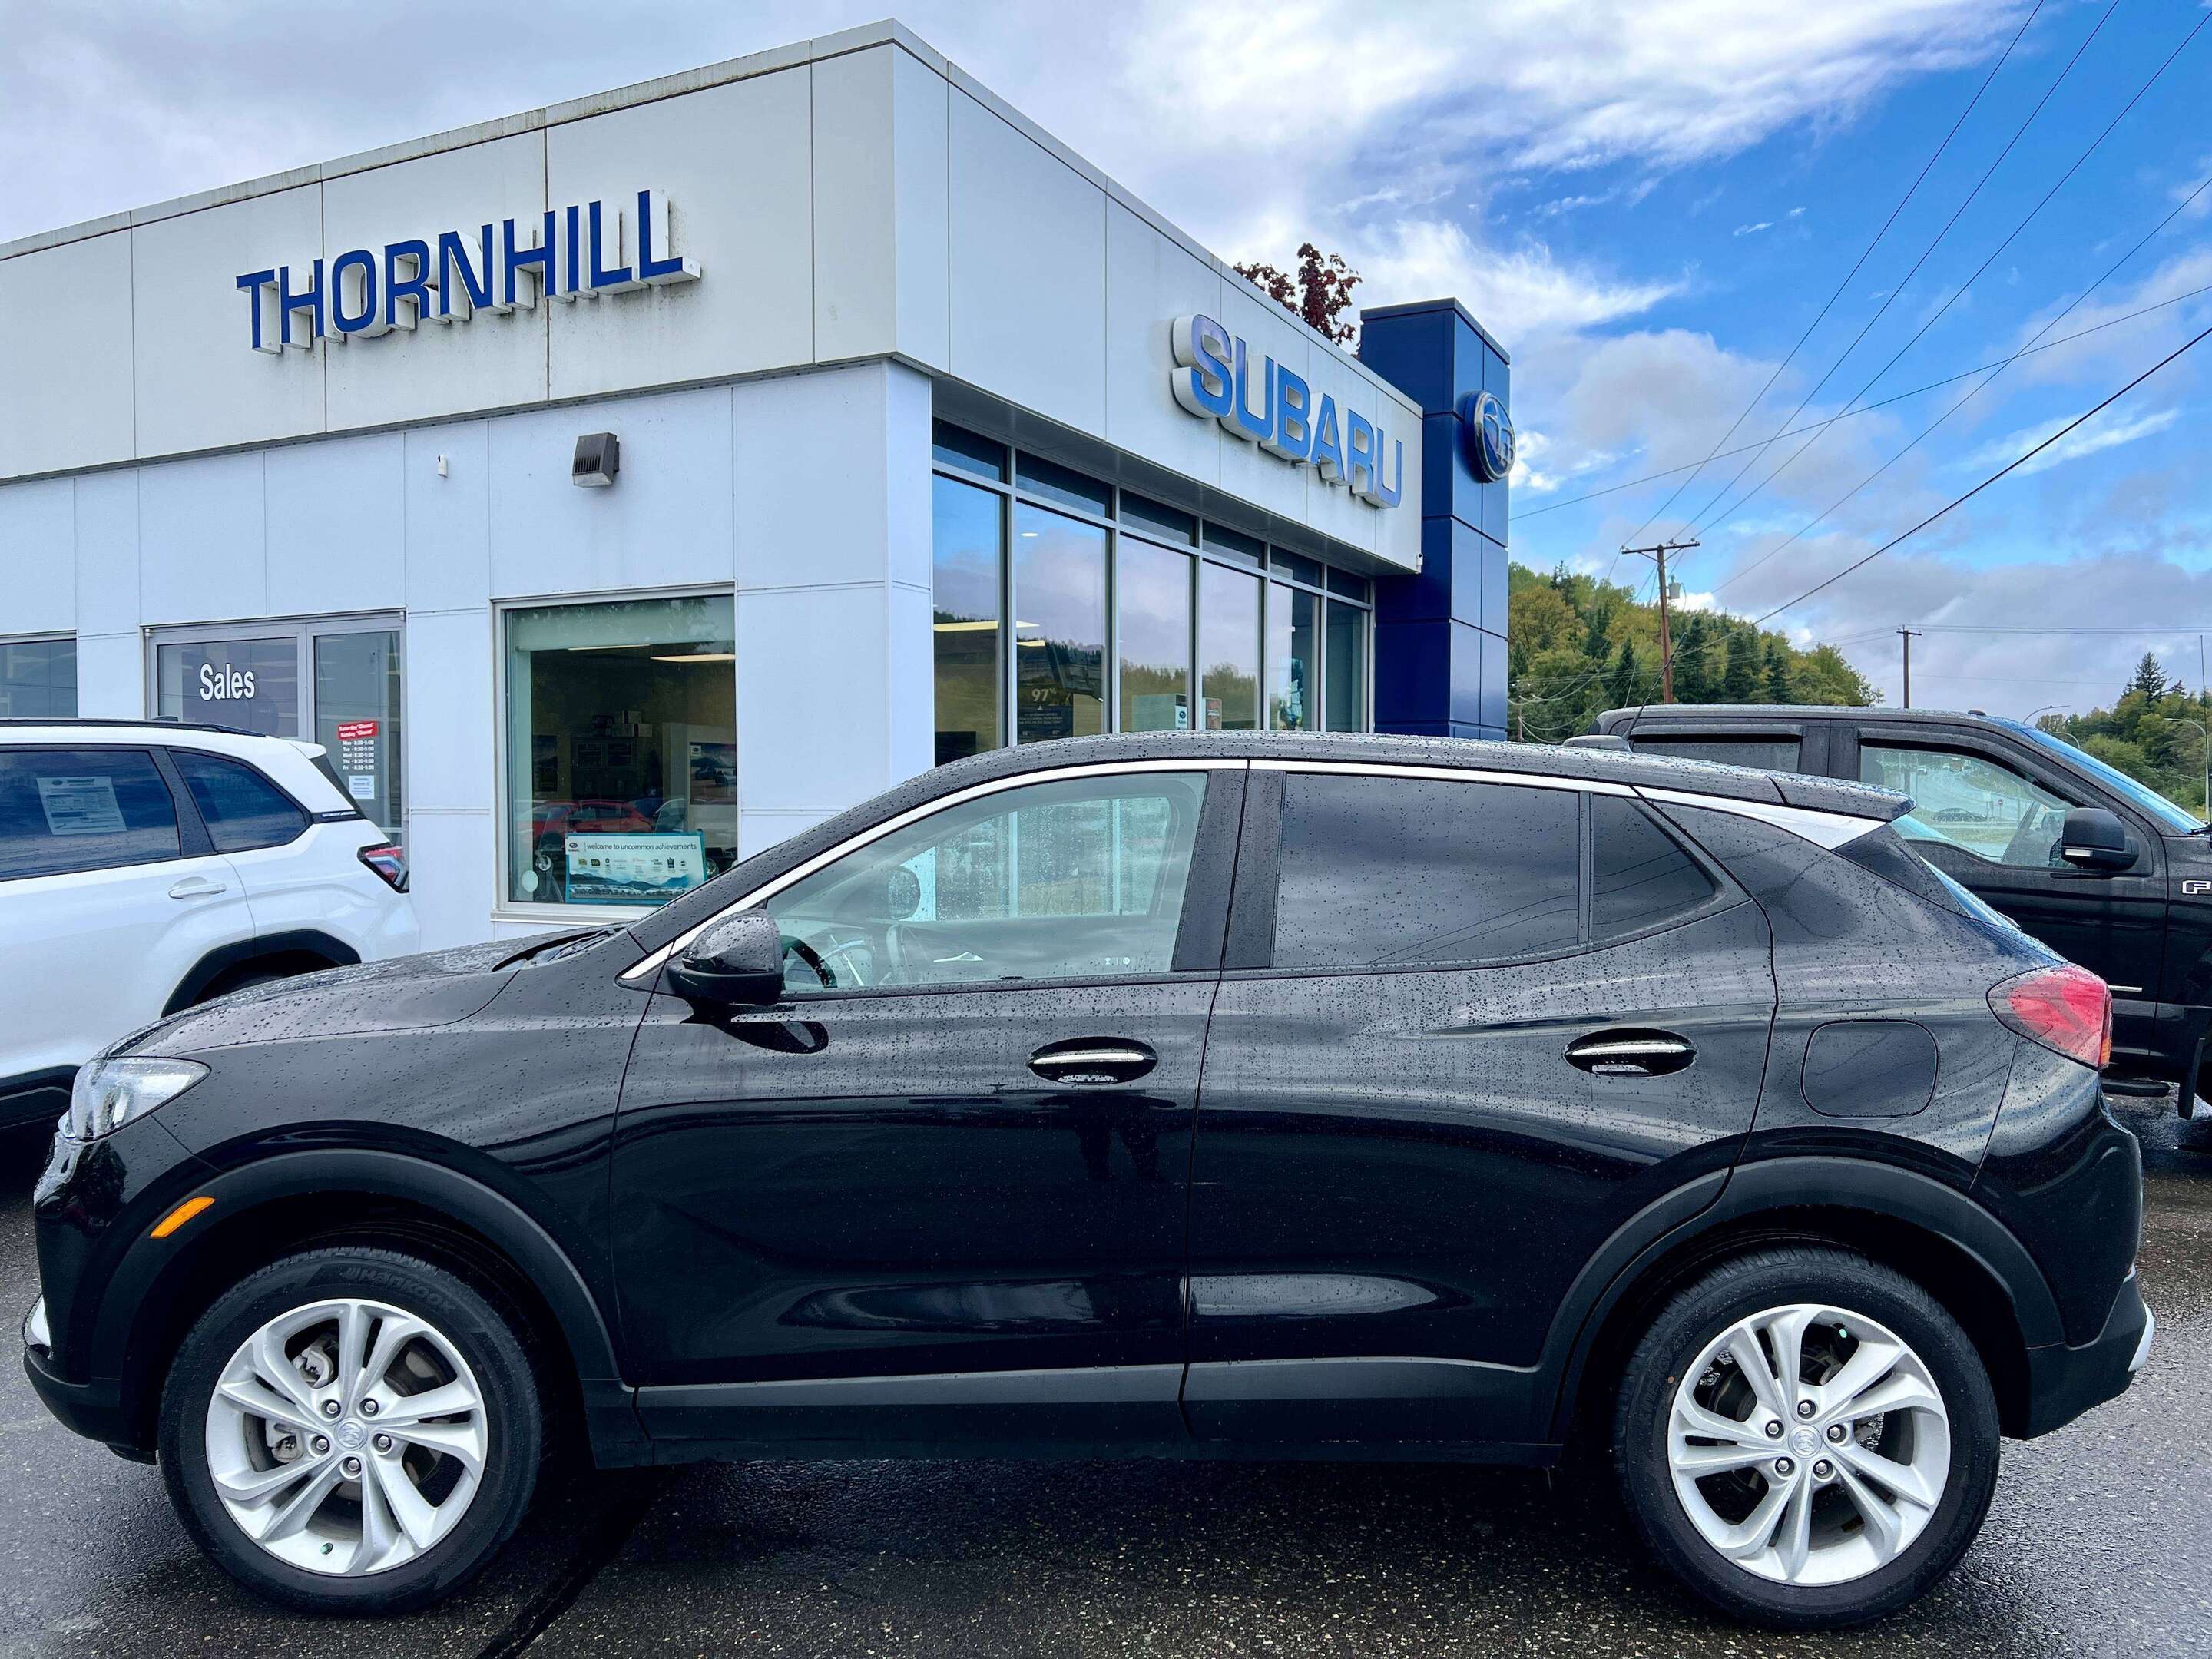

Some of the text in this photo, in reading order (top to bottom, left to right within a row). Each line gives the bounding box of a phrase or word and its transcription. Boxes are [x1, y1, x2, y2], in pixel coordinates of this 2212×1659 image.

[235, 190, 689, 352] THORNHILL
[1180, 313, 1402, 509] SUBARU
[200, 663, 255, 700] Sales
[587, 842, 612, 850] welcome
